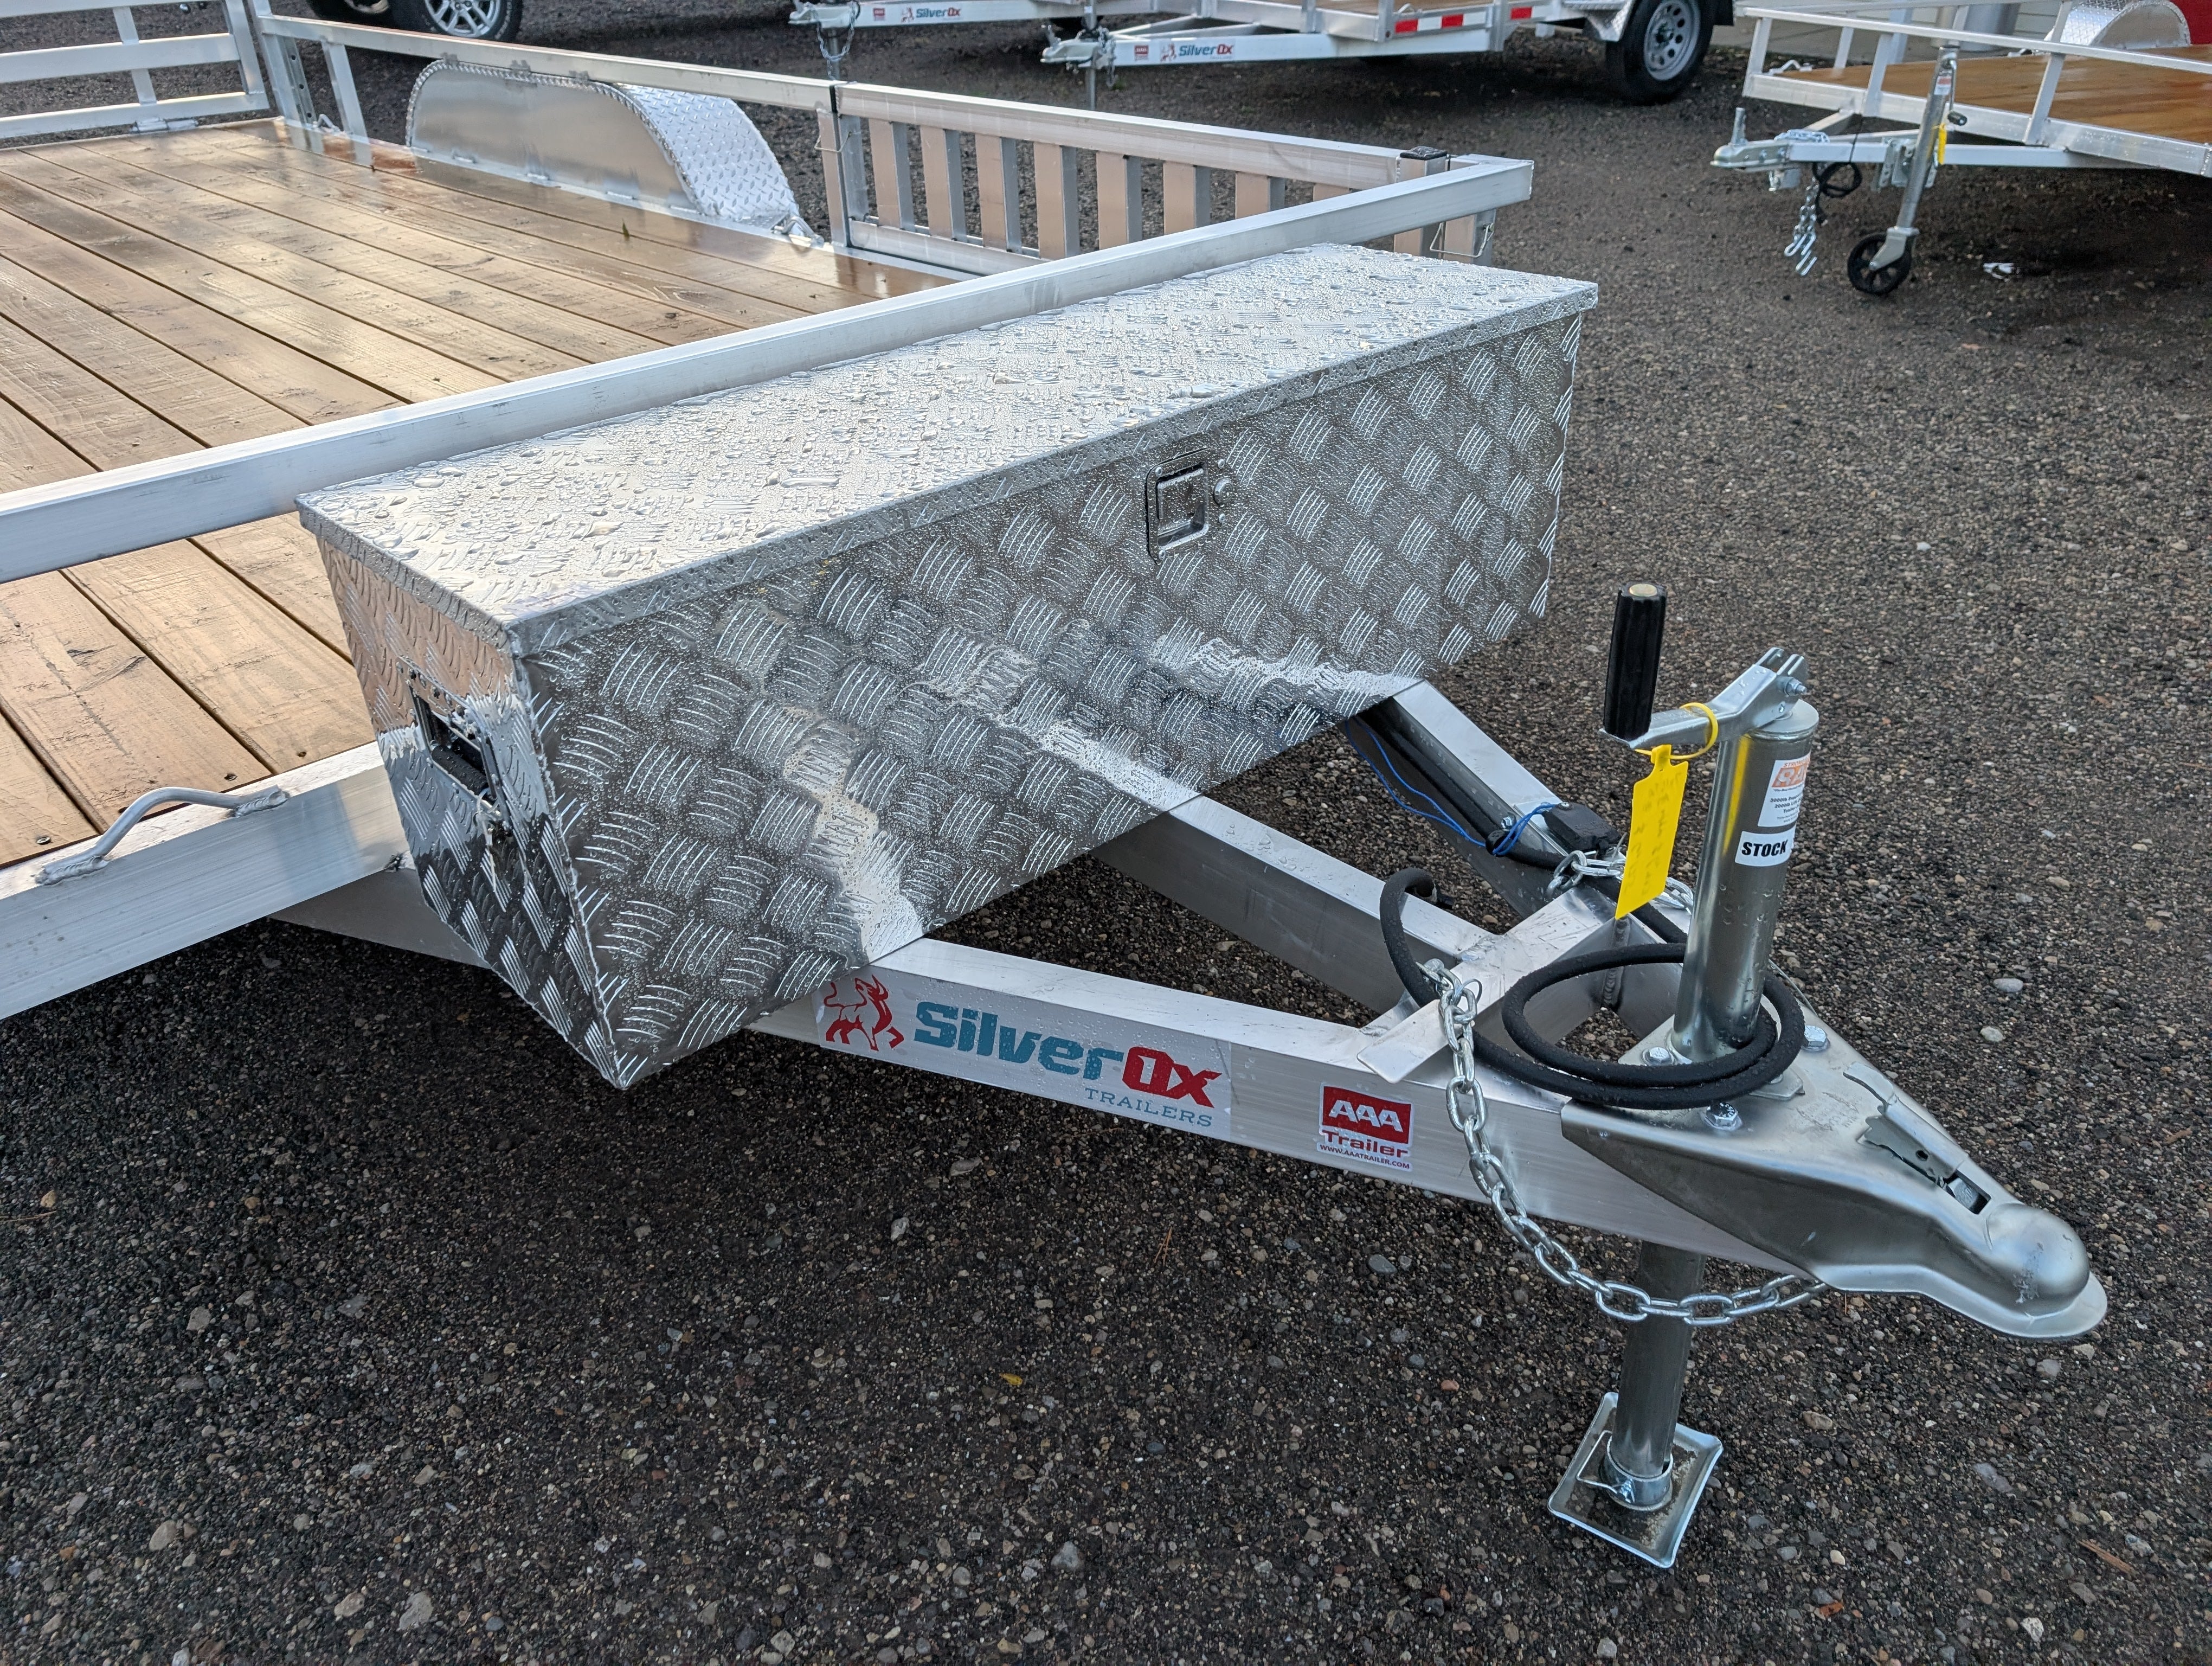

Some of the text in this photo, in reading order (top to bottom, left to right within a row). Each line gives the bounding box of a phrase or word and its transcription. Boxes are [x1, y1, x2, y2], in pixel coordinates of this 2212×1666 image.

[1179, 43, 1234, 56] SilverOx
[1741, 839, 1788, 857] STOCK
[914, 1001, 1222, 1108] SilverOx
[1085, 1087, 1212, 1127] TRAILERS
[1328, 1099, 1403, 1132] AAA
[1320, 1144, 1410, 1169] WWW.AAATRAILER.COM
[1322, 1130, 1408, 1158] Trailer
